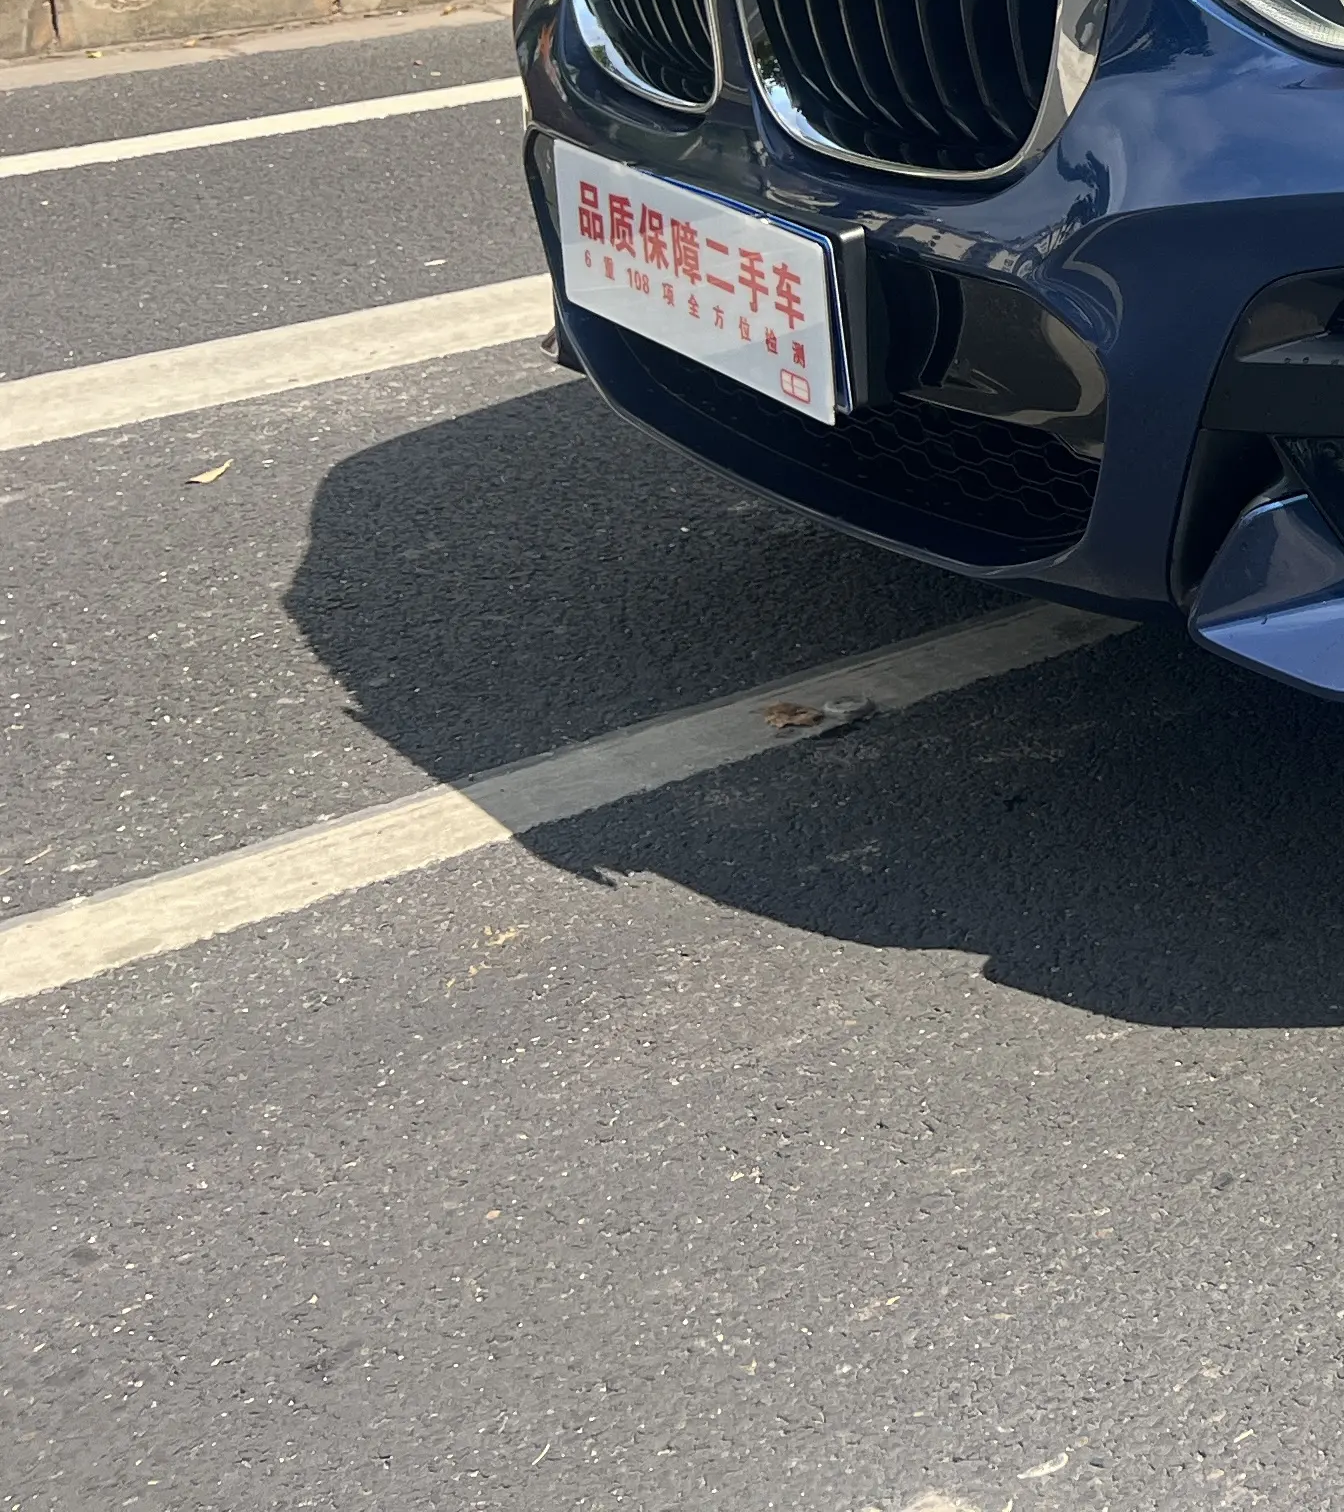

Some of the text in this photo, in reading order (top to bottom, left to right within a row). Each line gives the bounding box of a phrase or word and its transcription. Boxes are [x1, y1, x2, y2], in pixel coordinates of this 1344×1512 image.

[578, 180, 805, 330] 品质保障二手车
